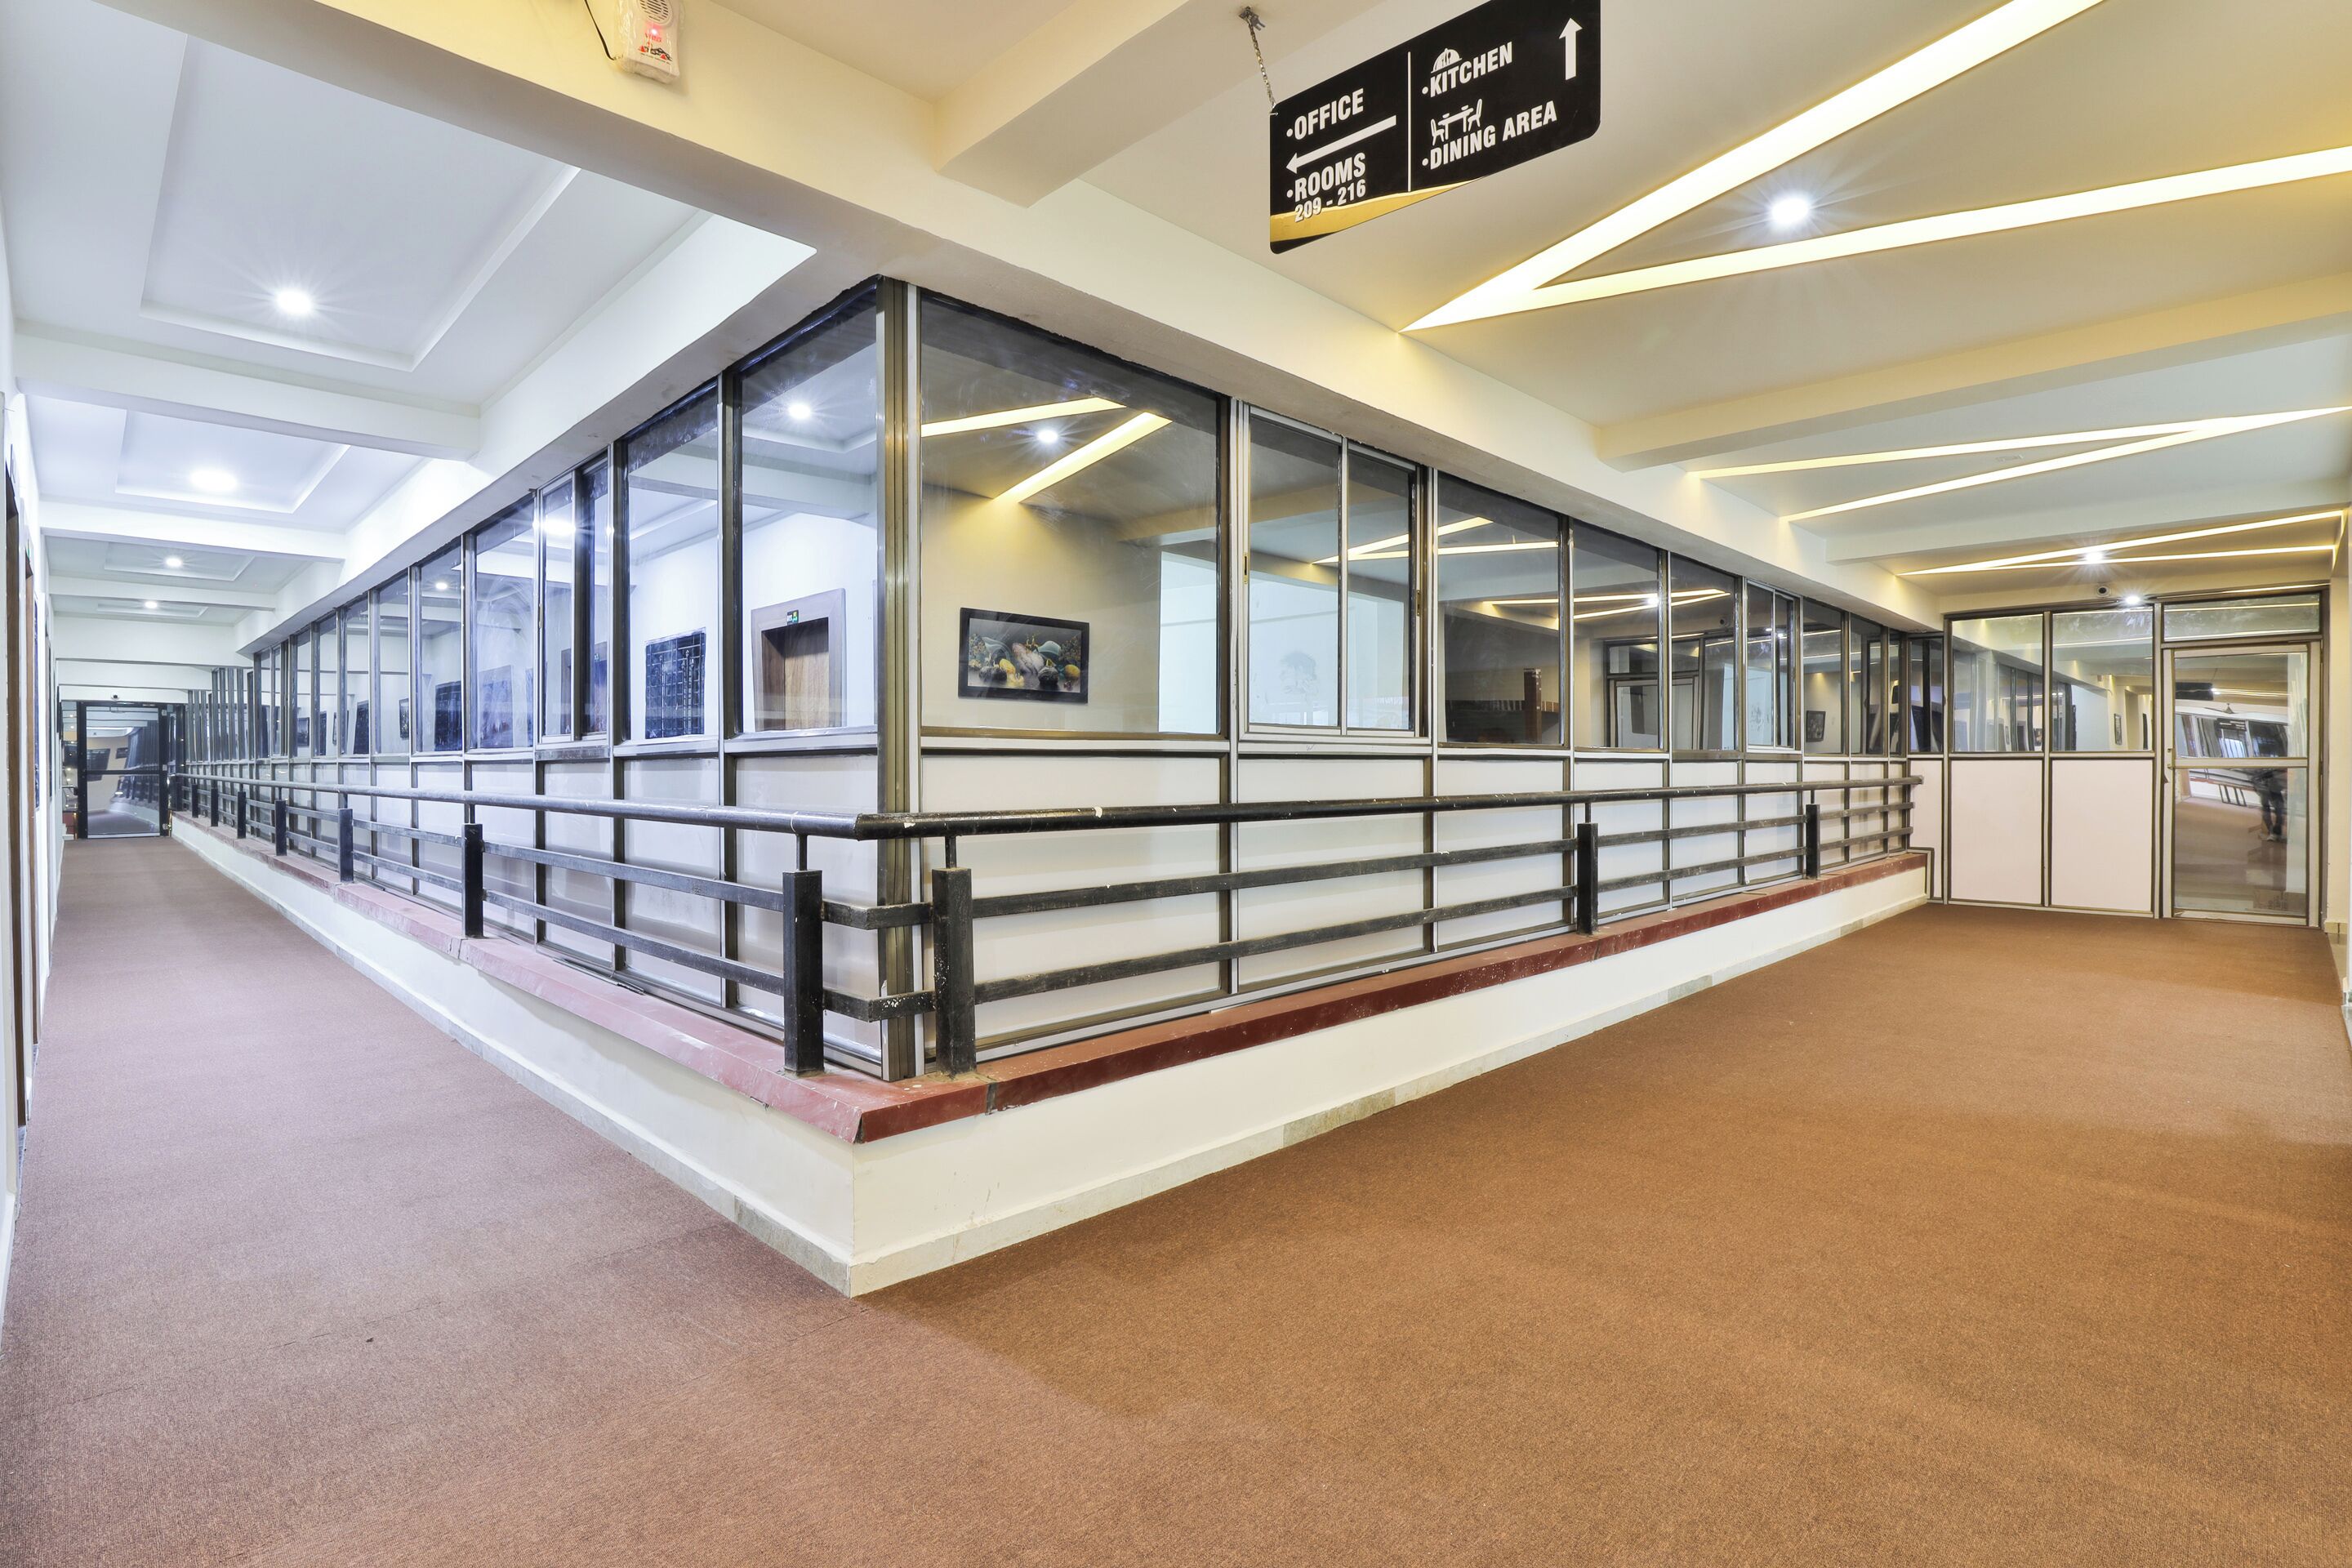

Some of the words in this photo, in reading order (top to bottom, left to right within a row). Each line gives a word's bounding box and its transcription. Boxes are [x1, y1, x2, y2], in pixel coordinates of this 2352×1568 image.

[1430, 42, 1512, 98] KITCHEN
[1294, 88, 1364, 140] OFFICE
[1430, 125, 1496, 170] DINING
[1502, 100, 1557, 141] AREA
[1294, 152, 1366, 203] ROOMS
[1294, 197, 1322, 223] 209
[1338, 179, 1366, 206] 216
